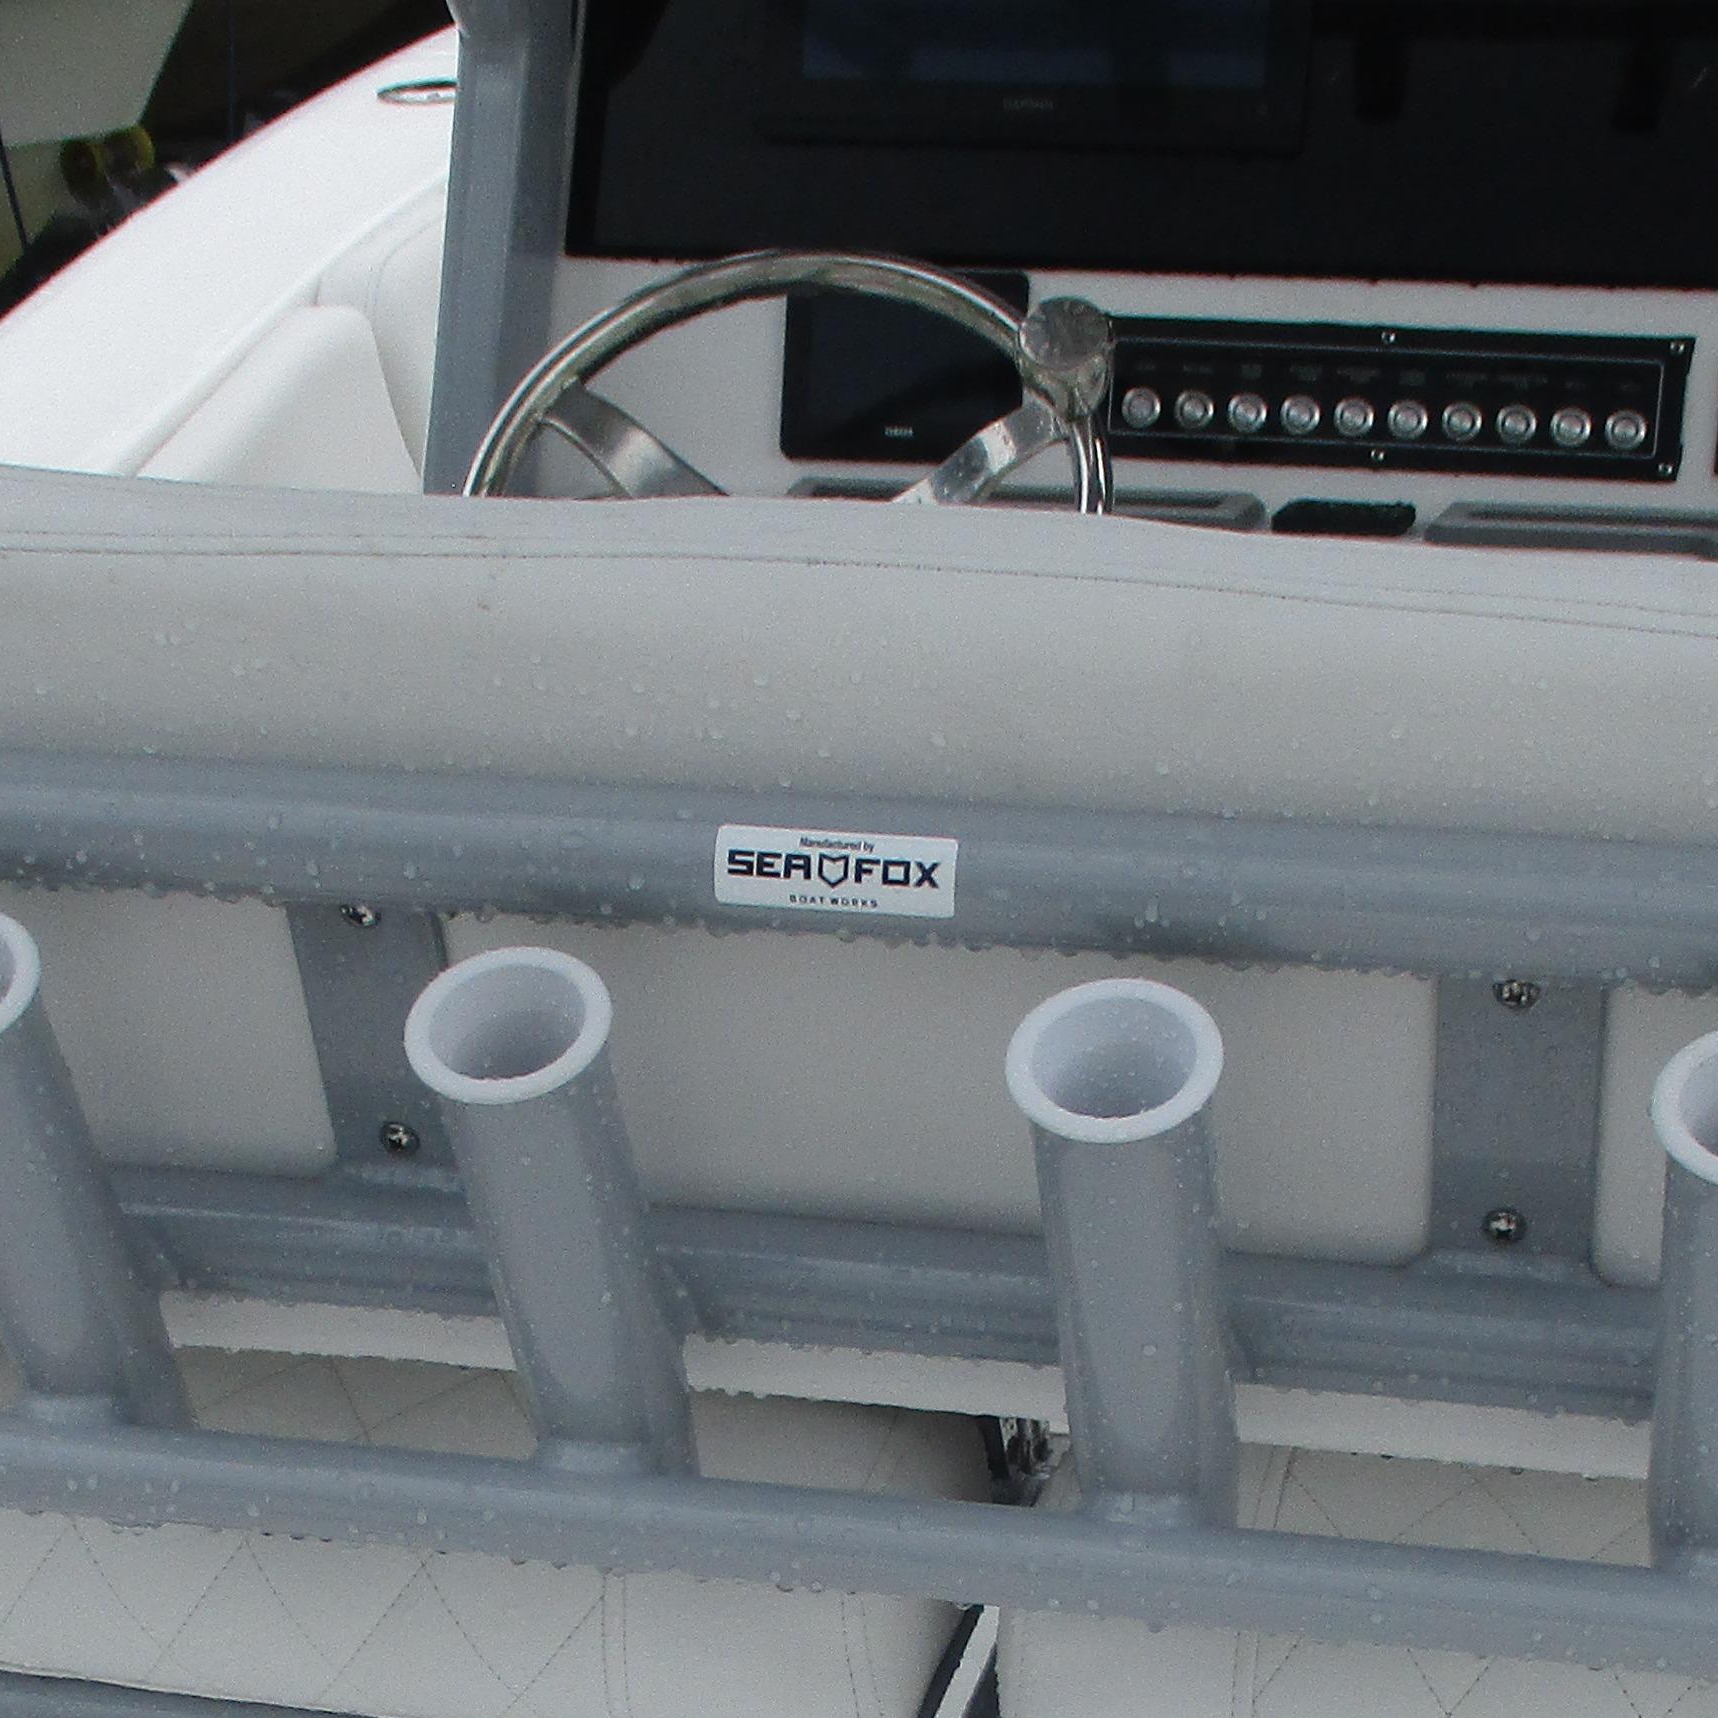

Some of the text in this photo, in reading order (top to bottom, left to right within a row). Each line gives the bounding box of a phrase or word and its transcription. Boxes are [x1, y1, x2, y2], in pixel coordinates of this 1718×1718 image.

[727, 849, 940, 888] SEA FOX
[789, 894, 878, 908] BOAT WORKS
